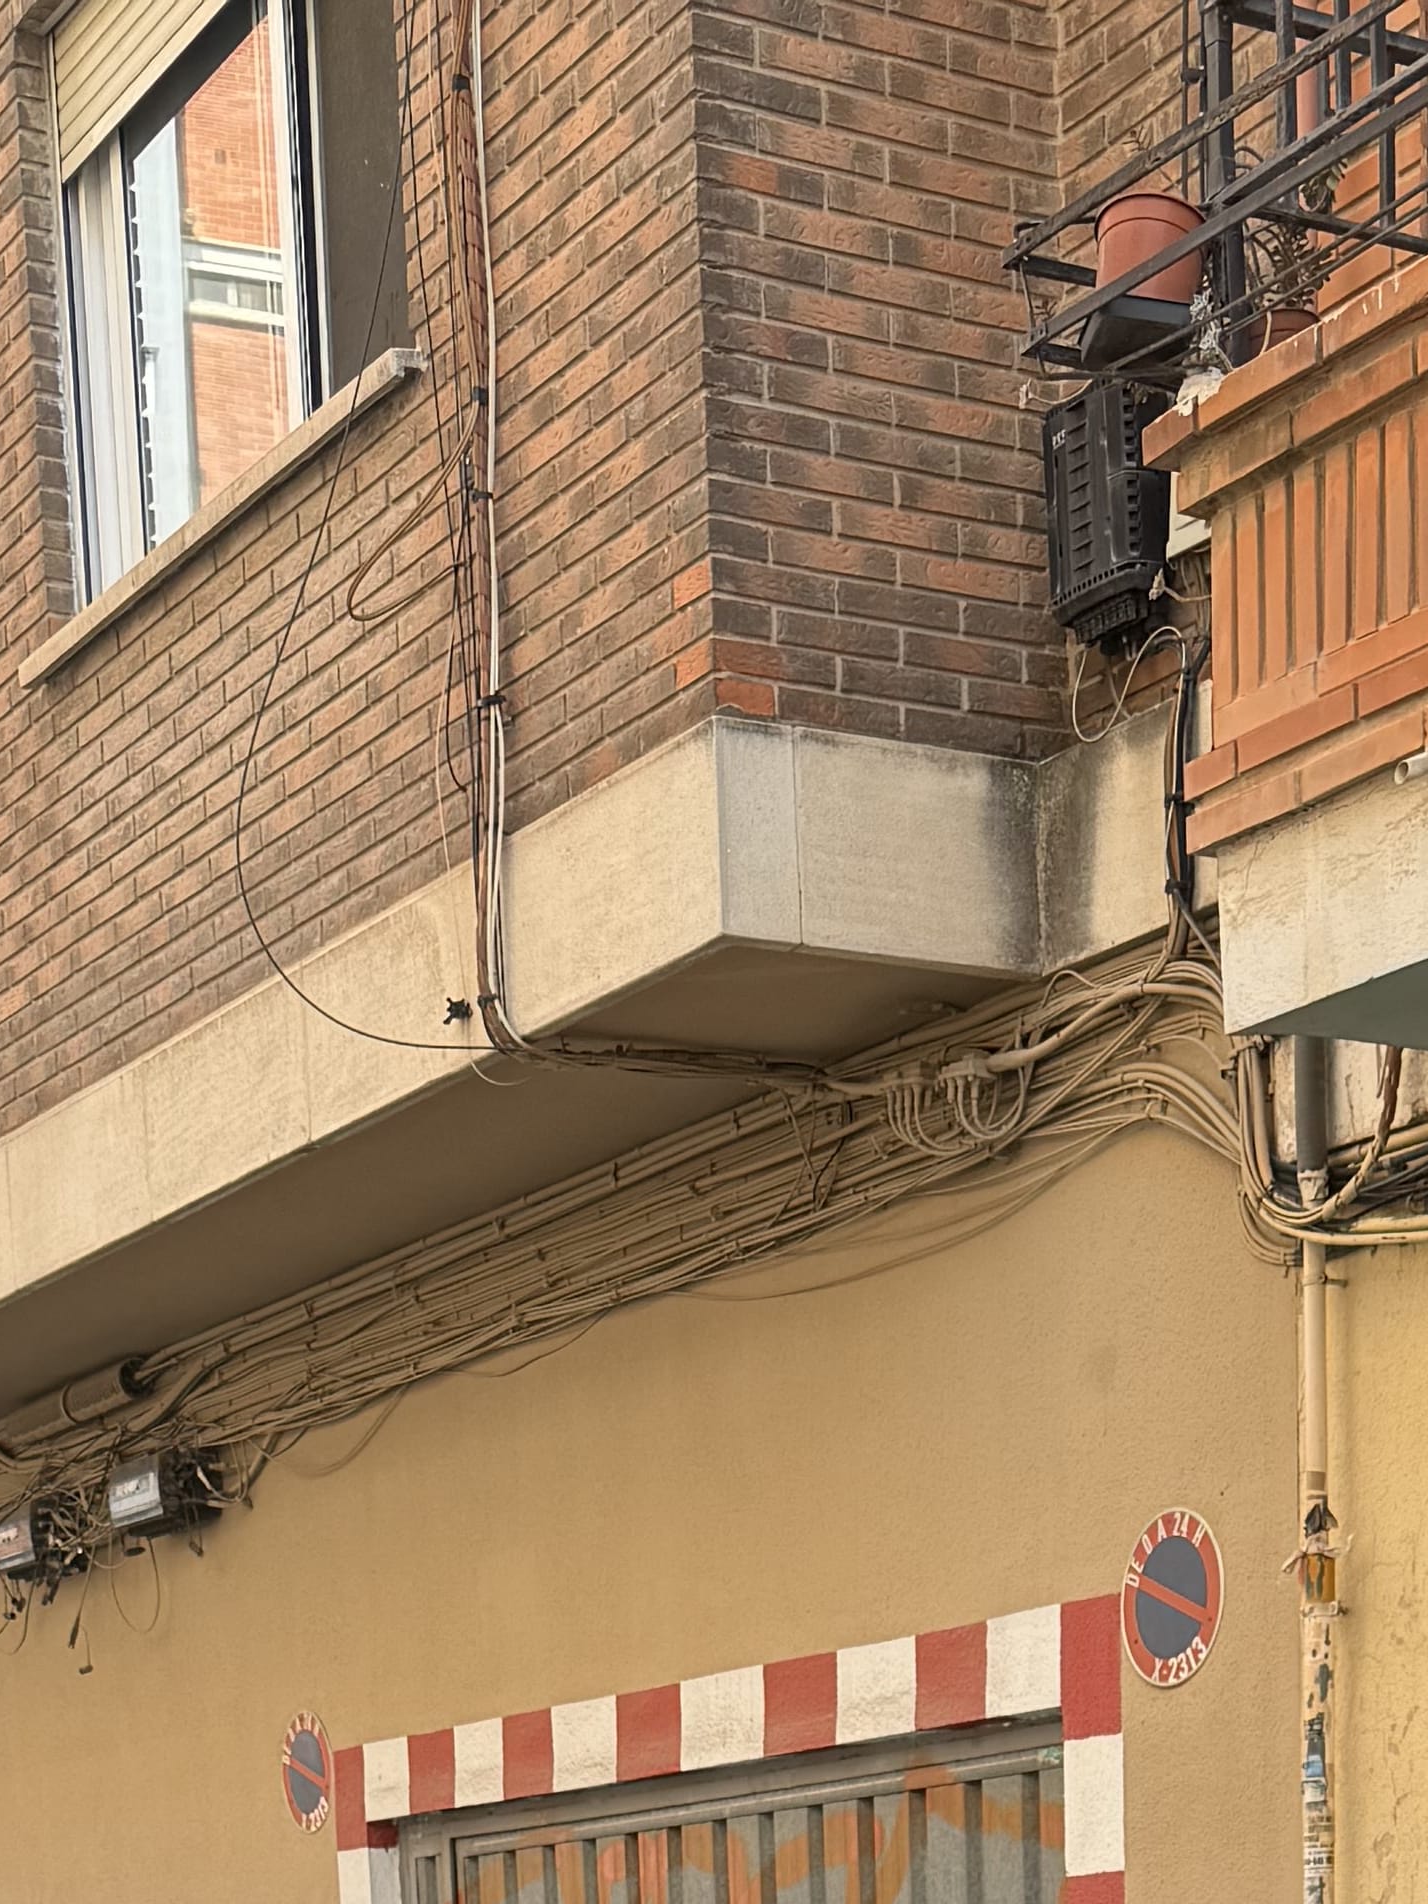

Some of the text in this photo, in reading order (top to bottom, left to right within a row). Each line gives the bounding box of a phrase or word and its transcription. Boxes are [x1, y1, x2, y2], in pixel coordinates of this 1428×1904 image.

[1125, 1557, 1145, 1587] DE
[1157, 1518, 1168, 1542] A
[1172, 1511, 1190, 1537] 24
[1192, 1523, 1207, 1548] H
